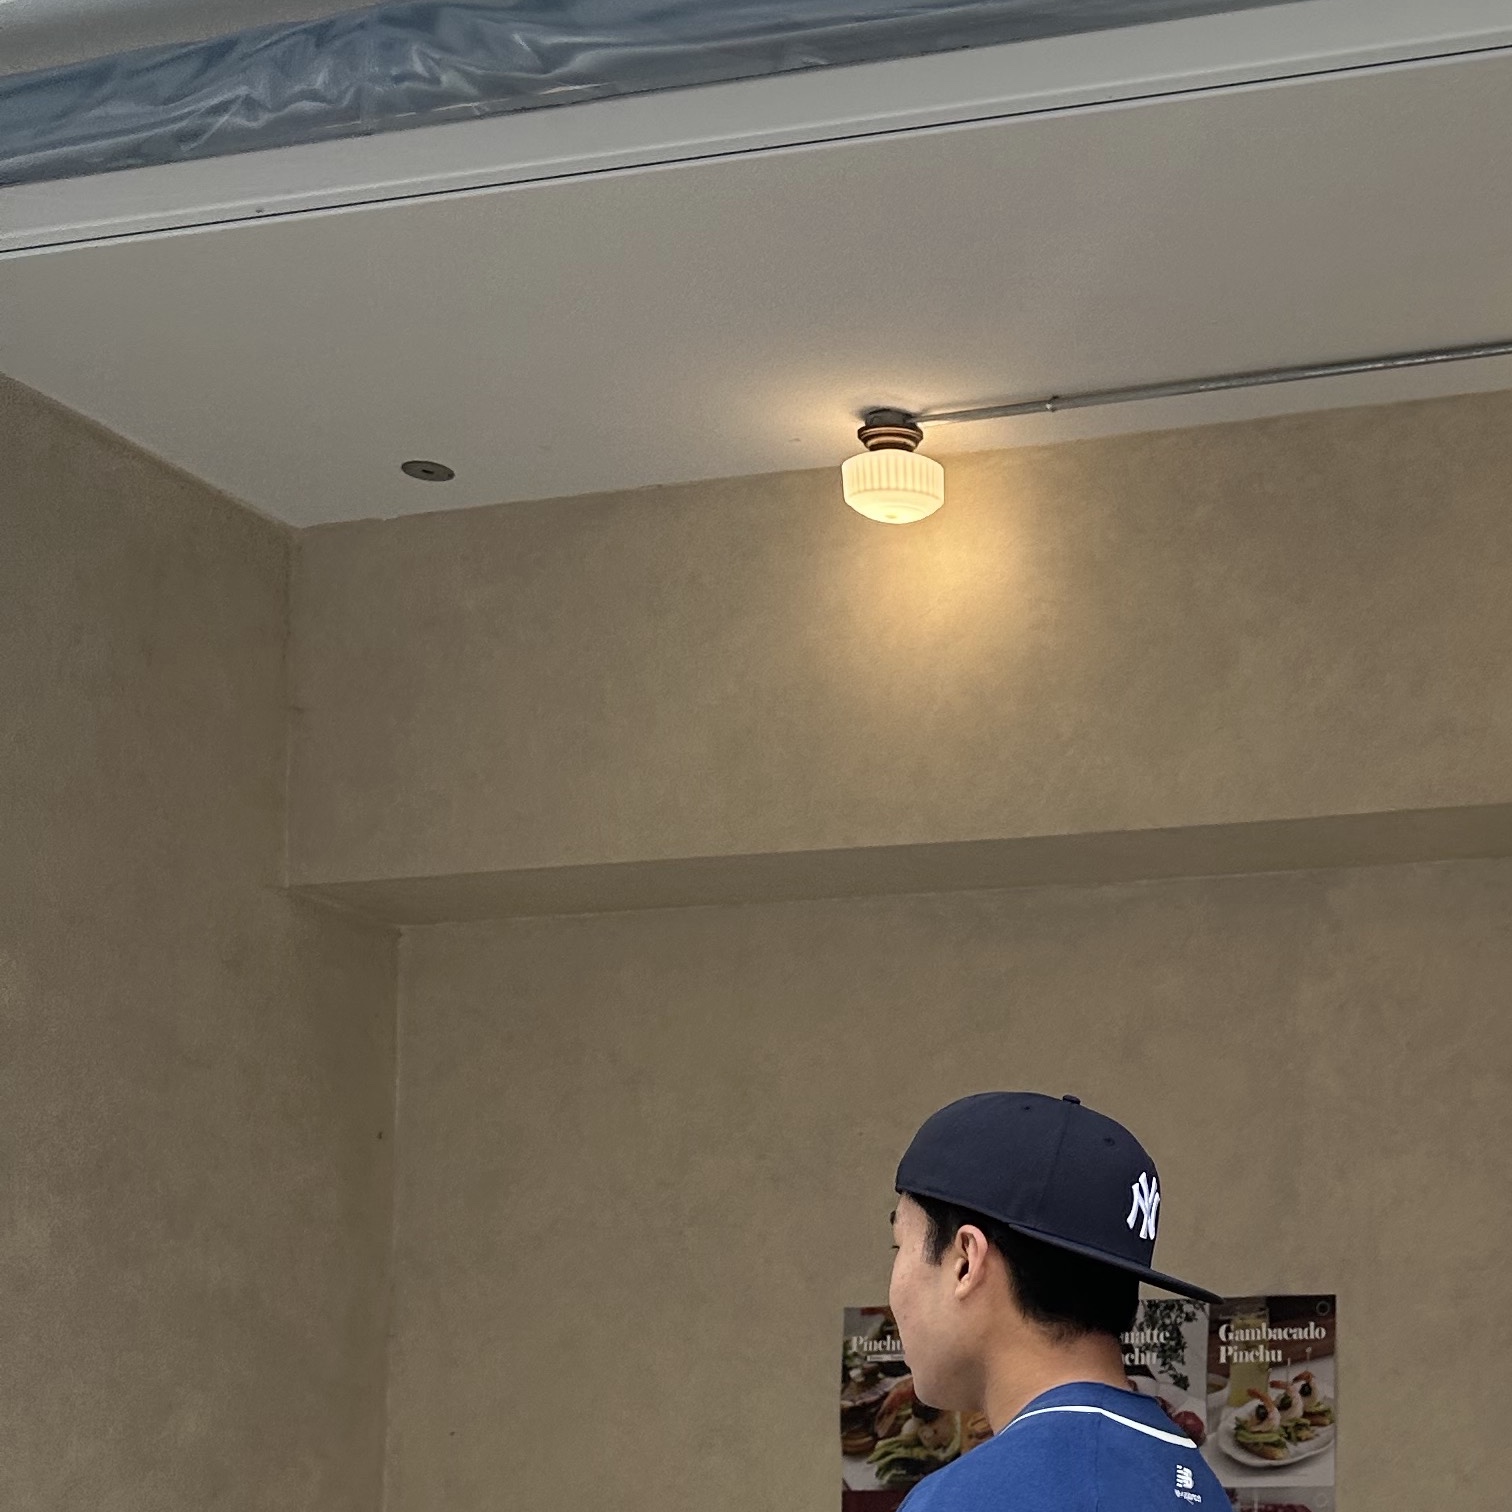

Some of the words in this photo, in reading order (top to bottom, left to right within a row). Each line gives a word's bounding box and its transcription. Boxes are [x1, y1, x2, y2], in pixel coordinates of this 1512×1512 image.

[1126, 1171, 1161, 1241] NY
[1217, 1321, 1327, 1343] Gambacado
[1217, 1344, 1283, 1364] Pinchu
